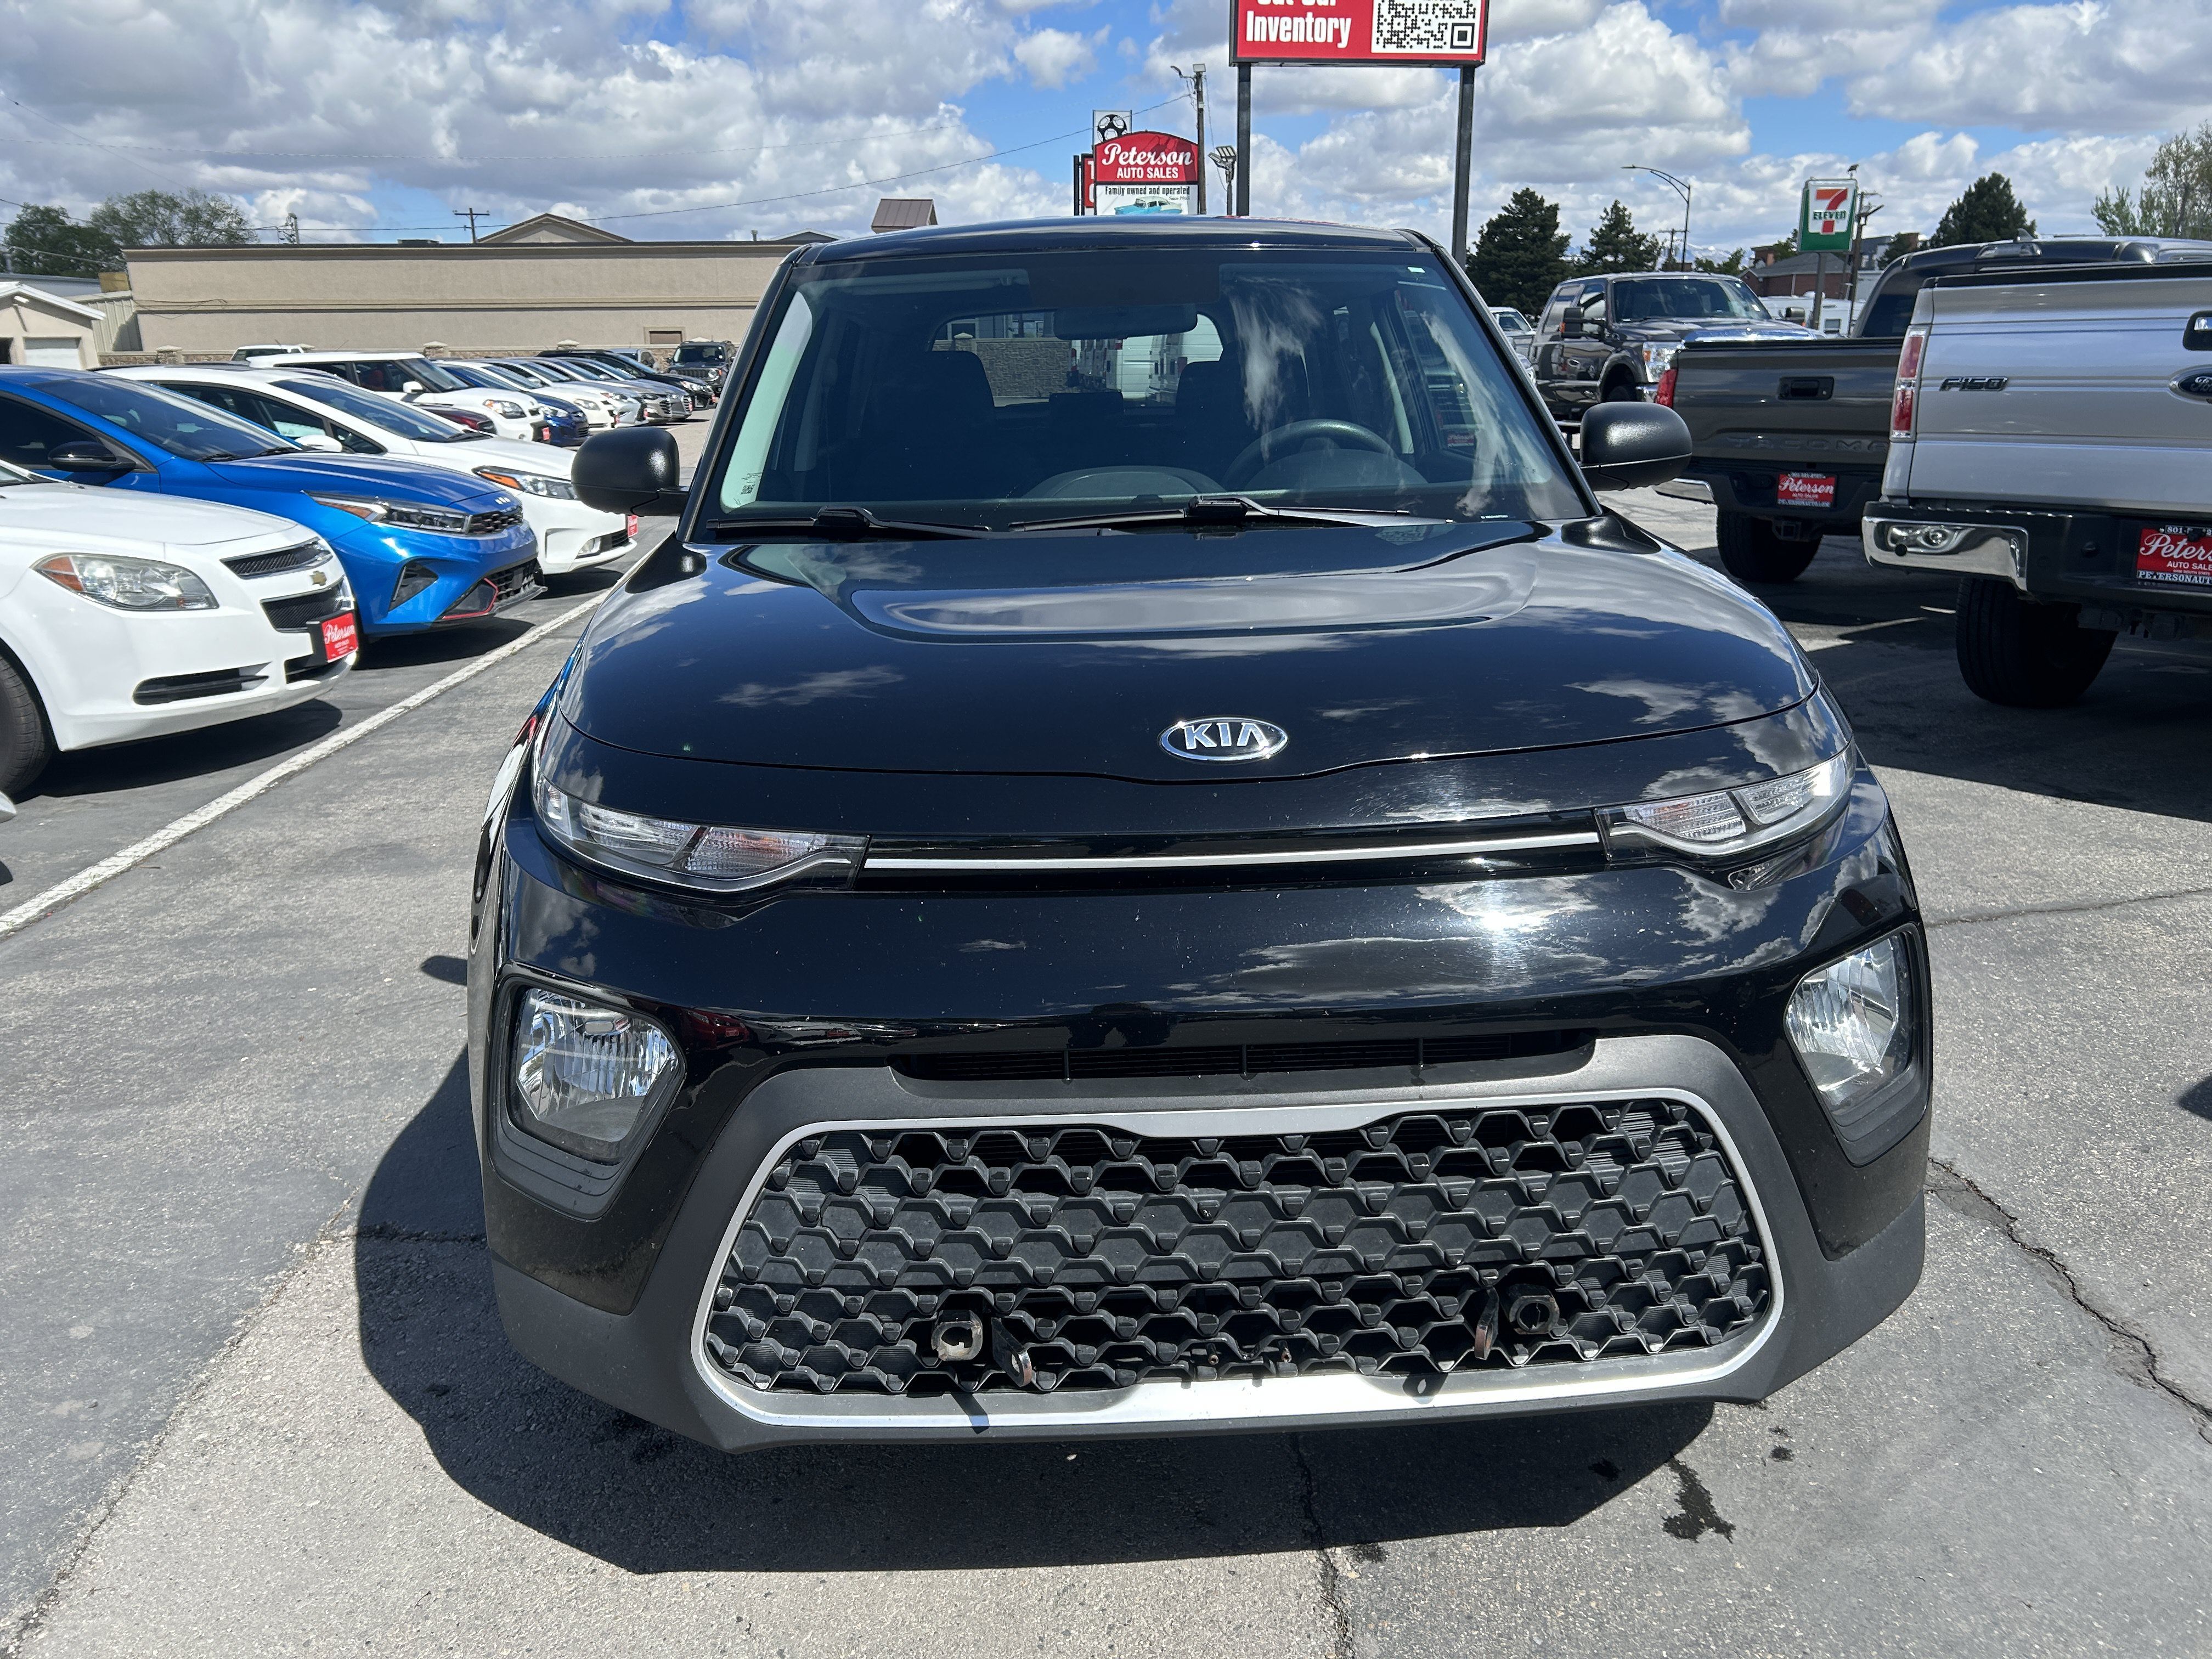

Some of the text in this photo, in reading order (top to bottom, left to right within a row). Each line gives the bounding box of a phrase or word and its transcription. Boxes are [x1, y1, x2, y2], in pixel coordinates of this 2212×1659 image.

[1246, 10, 1352, 48] Inventory
[1102, 143, 1193, 165] Peterson
[1117, 167, 1179, 179] AUTO SALES
[1105, 186, 1125, 196] Family
[1127, 186, 1147, 195] owned
[1149, 186, 1160, 195] and
[1162, 186, 1190, 196] operated
[1816, 188, 1848, 233] 7
[1726, 437, 1888, 453] TACOMA
[1779, 477, 1834, 494] Peterson
[2166, 561, 2212, 571] AUTO SALE
[1183, 722, 1269, 750] KIA
